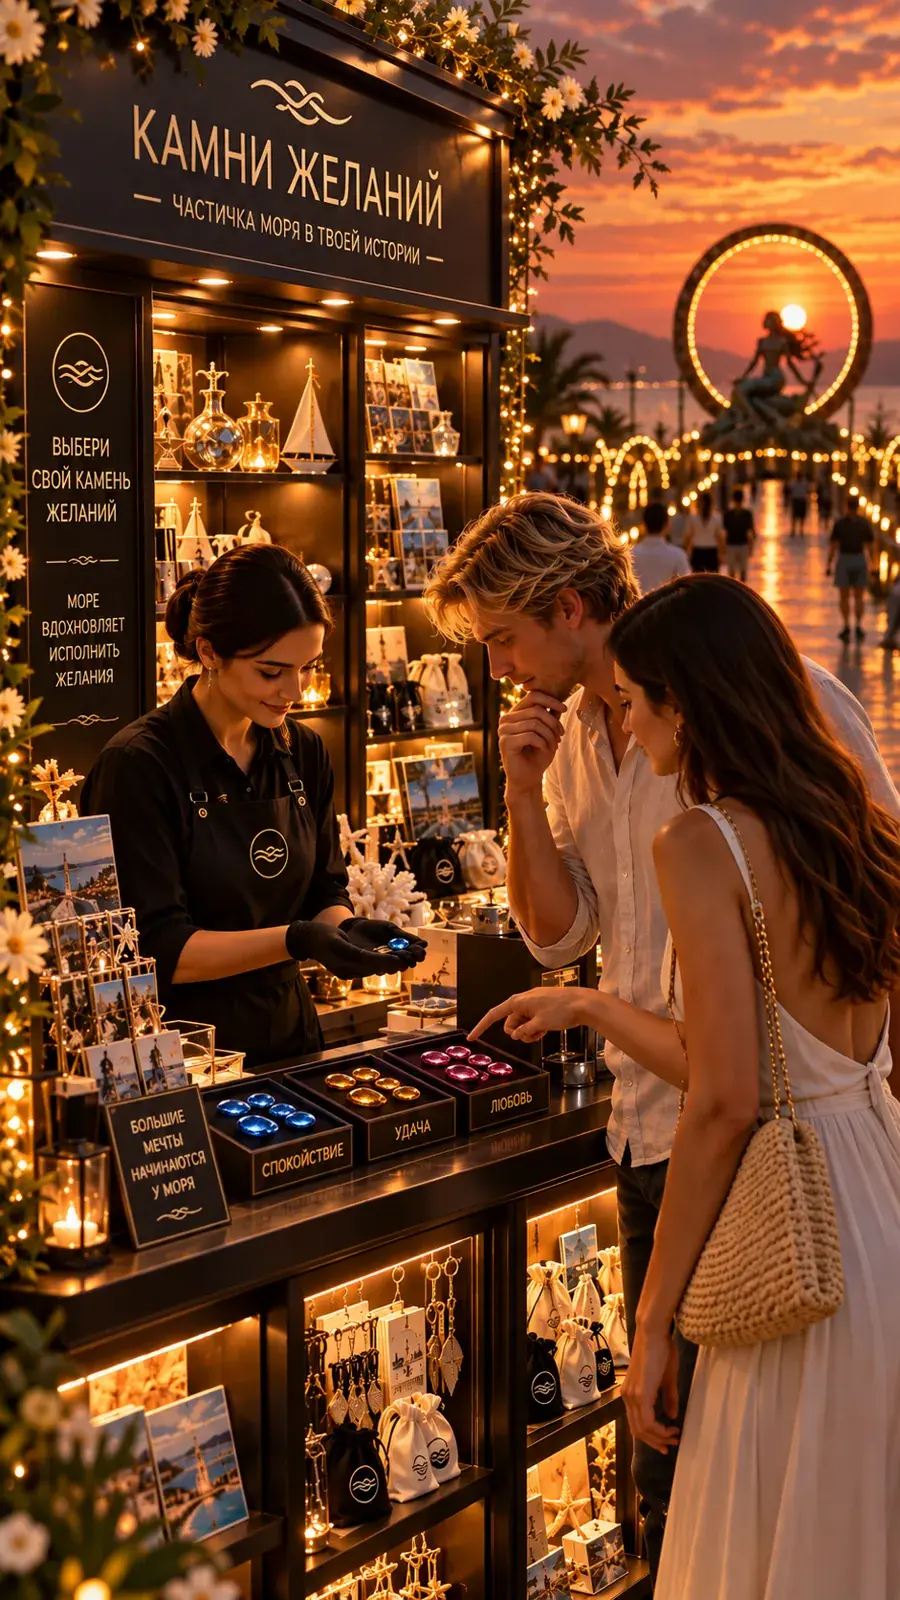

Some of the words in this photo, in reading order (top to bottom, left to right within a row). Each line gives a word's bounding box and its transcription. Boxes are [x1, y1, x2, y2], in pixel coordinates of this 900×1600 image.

[132, 104, 273, 190] КАМНИ
[286, 143, 443, 230] ЖЕЛАНИЙ
[172, 193, 256, 232] ЧАСТИЧКА
[260, 213, 300, 241] МОРЯ
[305, 223, 314, 243] В
[317, 225, 360, 253] ТВОЕЙ
[364, 236, 420, 266] ИСТОРИИ
[52, 436, 110, 457] ВЫБЕРИ
[31, 465, 71, 490] СВОЙ
[75, 470, 131, 490] КАМЕНЬ
[46, 499, 117, 523] ЖЕЛАНИЙ
[67, 592, 100, 609] МОРЕ
[42, 616, 125, 639] ВДОХНОВЛЯЕТ
[49, 643, 120, 662] ИСПОЛНИТЬ
[55, 668, 114, 688] ЖЕЛАНИЯ
[490, 1090, 533, 1114] ЛЮБОВЬ
[130, 1109, 186, 1135] БОЛЬШИЕ
[394, 1119, 432, 1142] УДАЧА
[142, 1133, 184, 1156] МЕЧТЫ
[130, 1150, 207, 1182] НАЧИНАЮТСЯ
[261, 1141, 345, 1178] СПОКОЙСТВИЕ
[151, 1184, 160, 1200] У
[164, 1175, 196, 1198] МОРЯ
